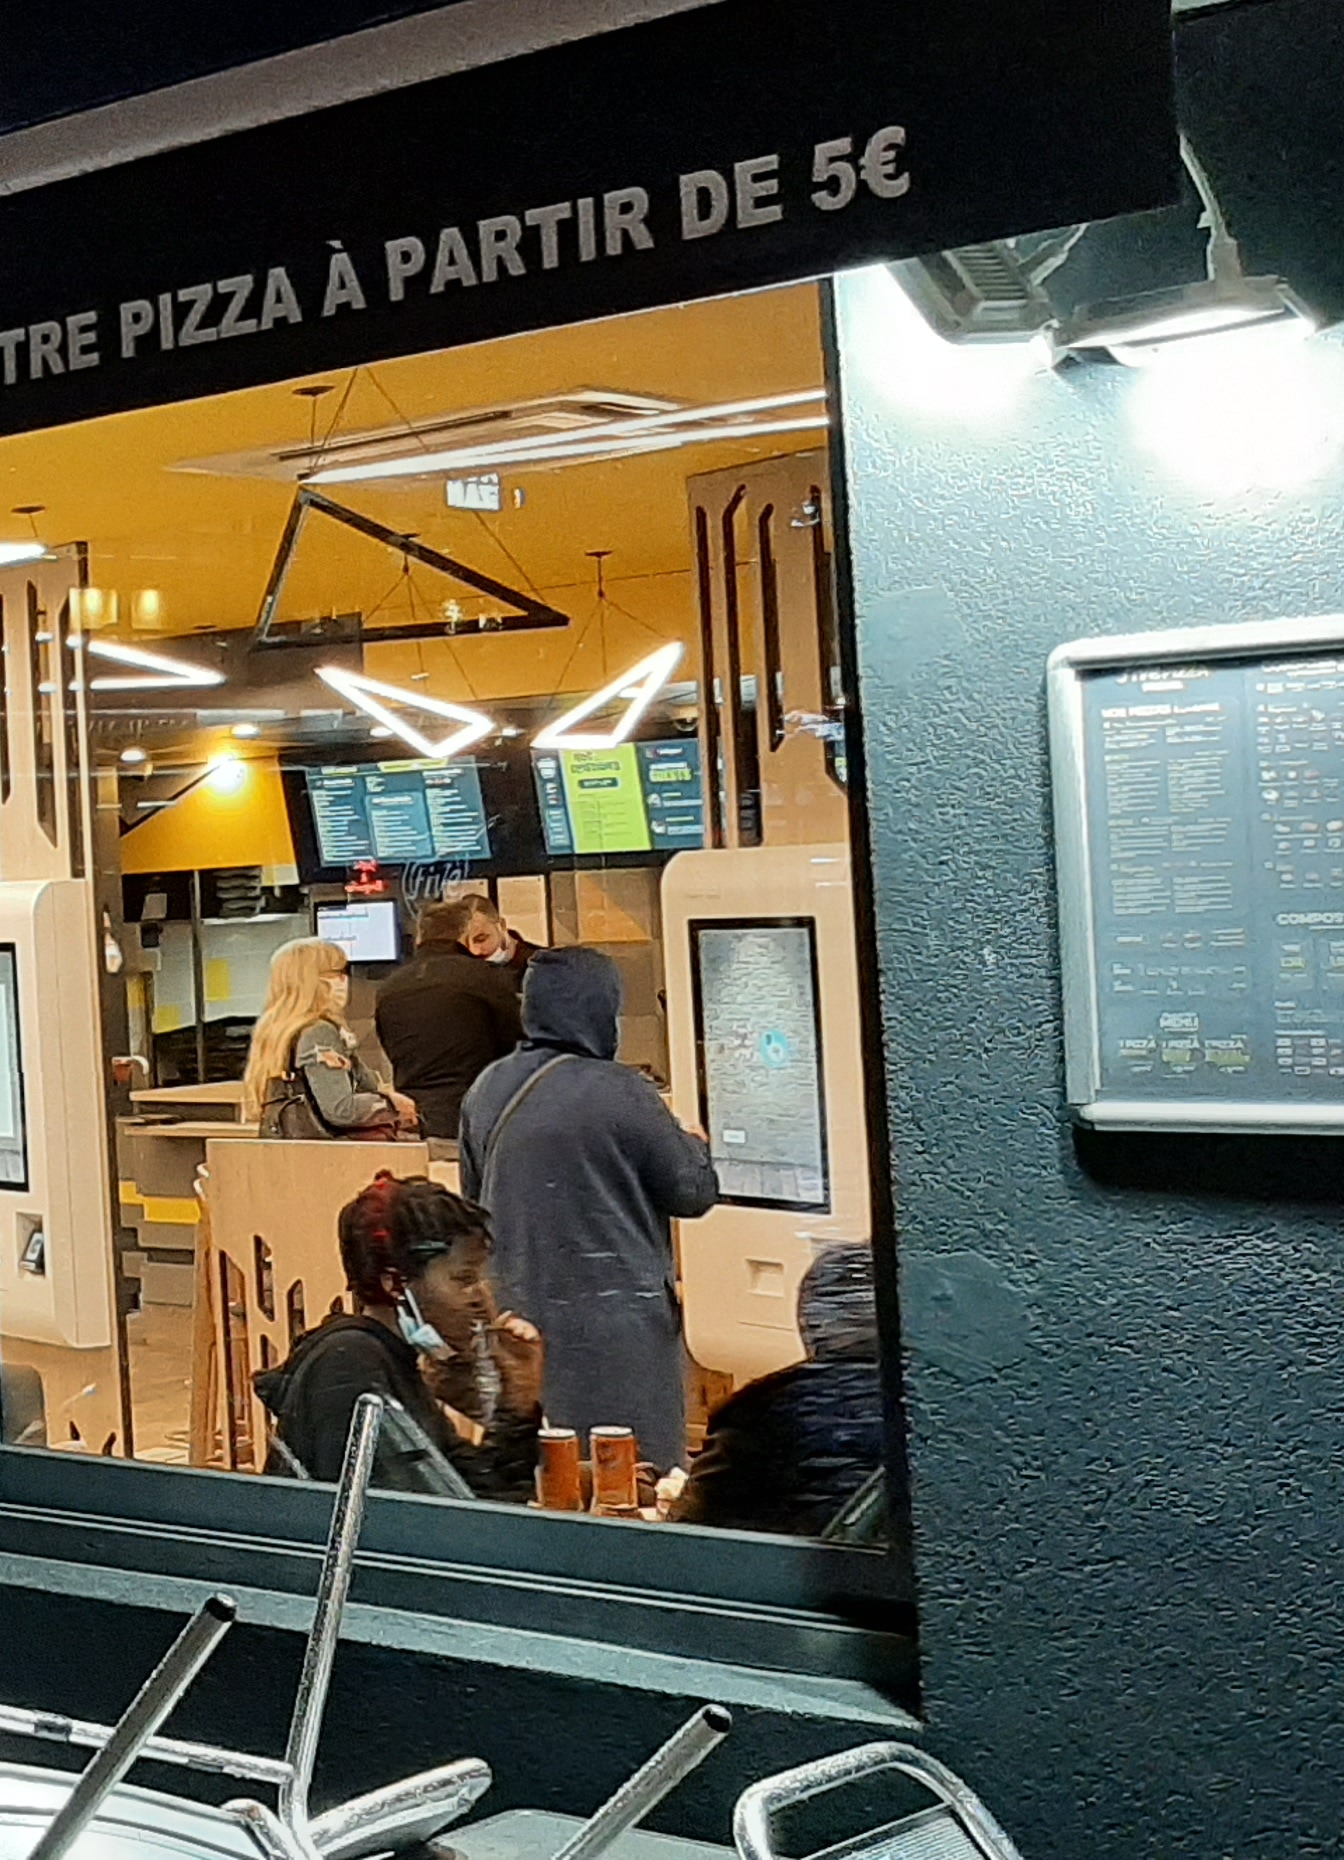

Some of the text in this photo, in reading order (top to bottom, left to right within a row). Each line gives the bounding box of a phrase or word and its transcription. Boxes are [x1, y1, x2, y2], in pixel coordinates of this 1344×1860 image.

[119, 266, 303, 358] PIZZA
[321, 241, 367, 316] À
[384, 186, 656, 301] PARTIR
[679, 154, 783, 241] DE
[811, 125, 912, 211] 5€
